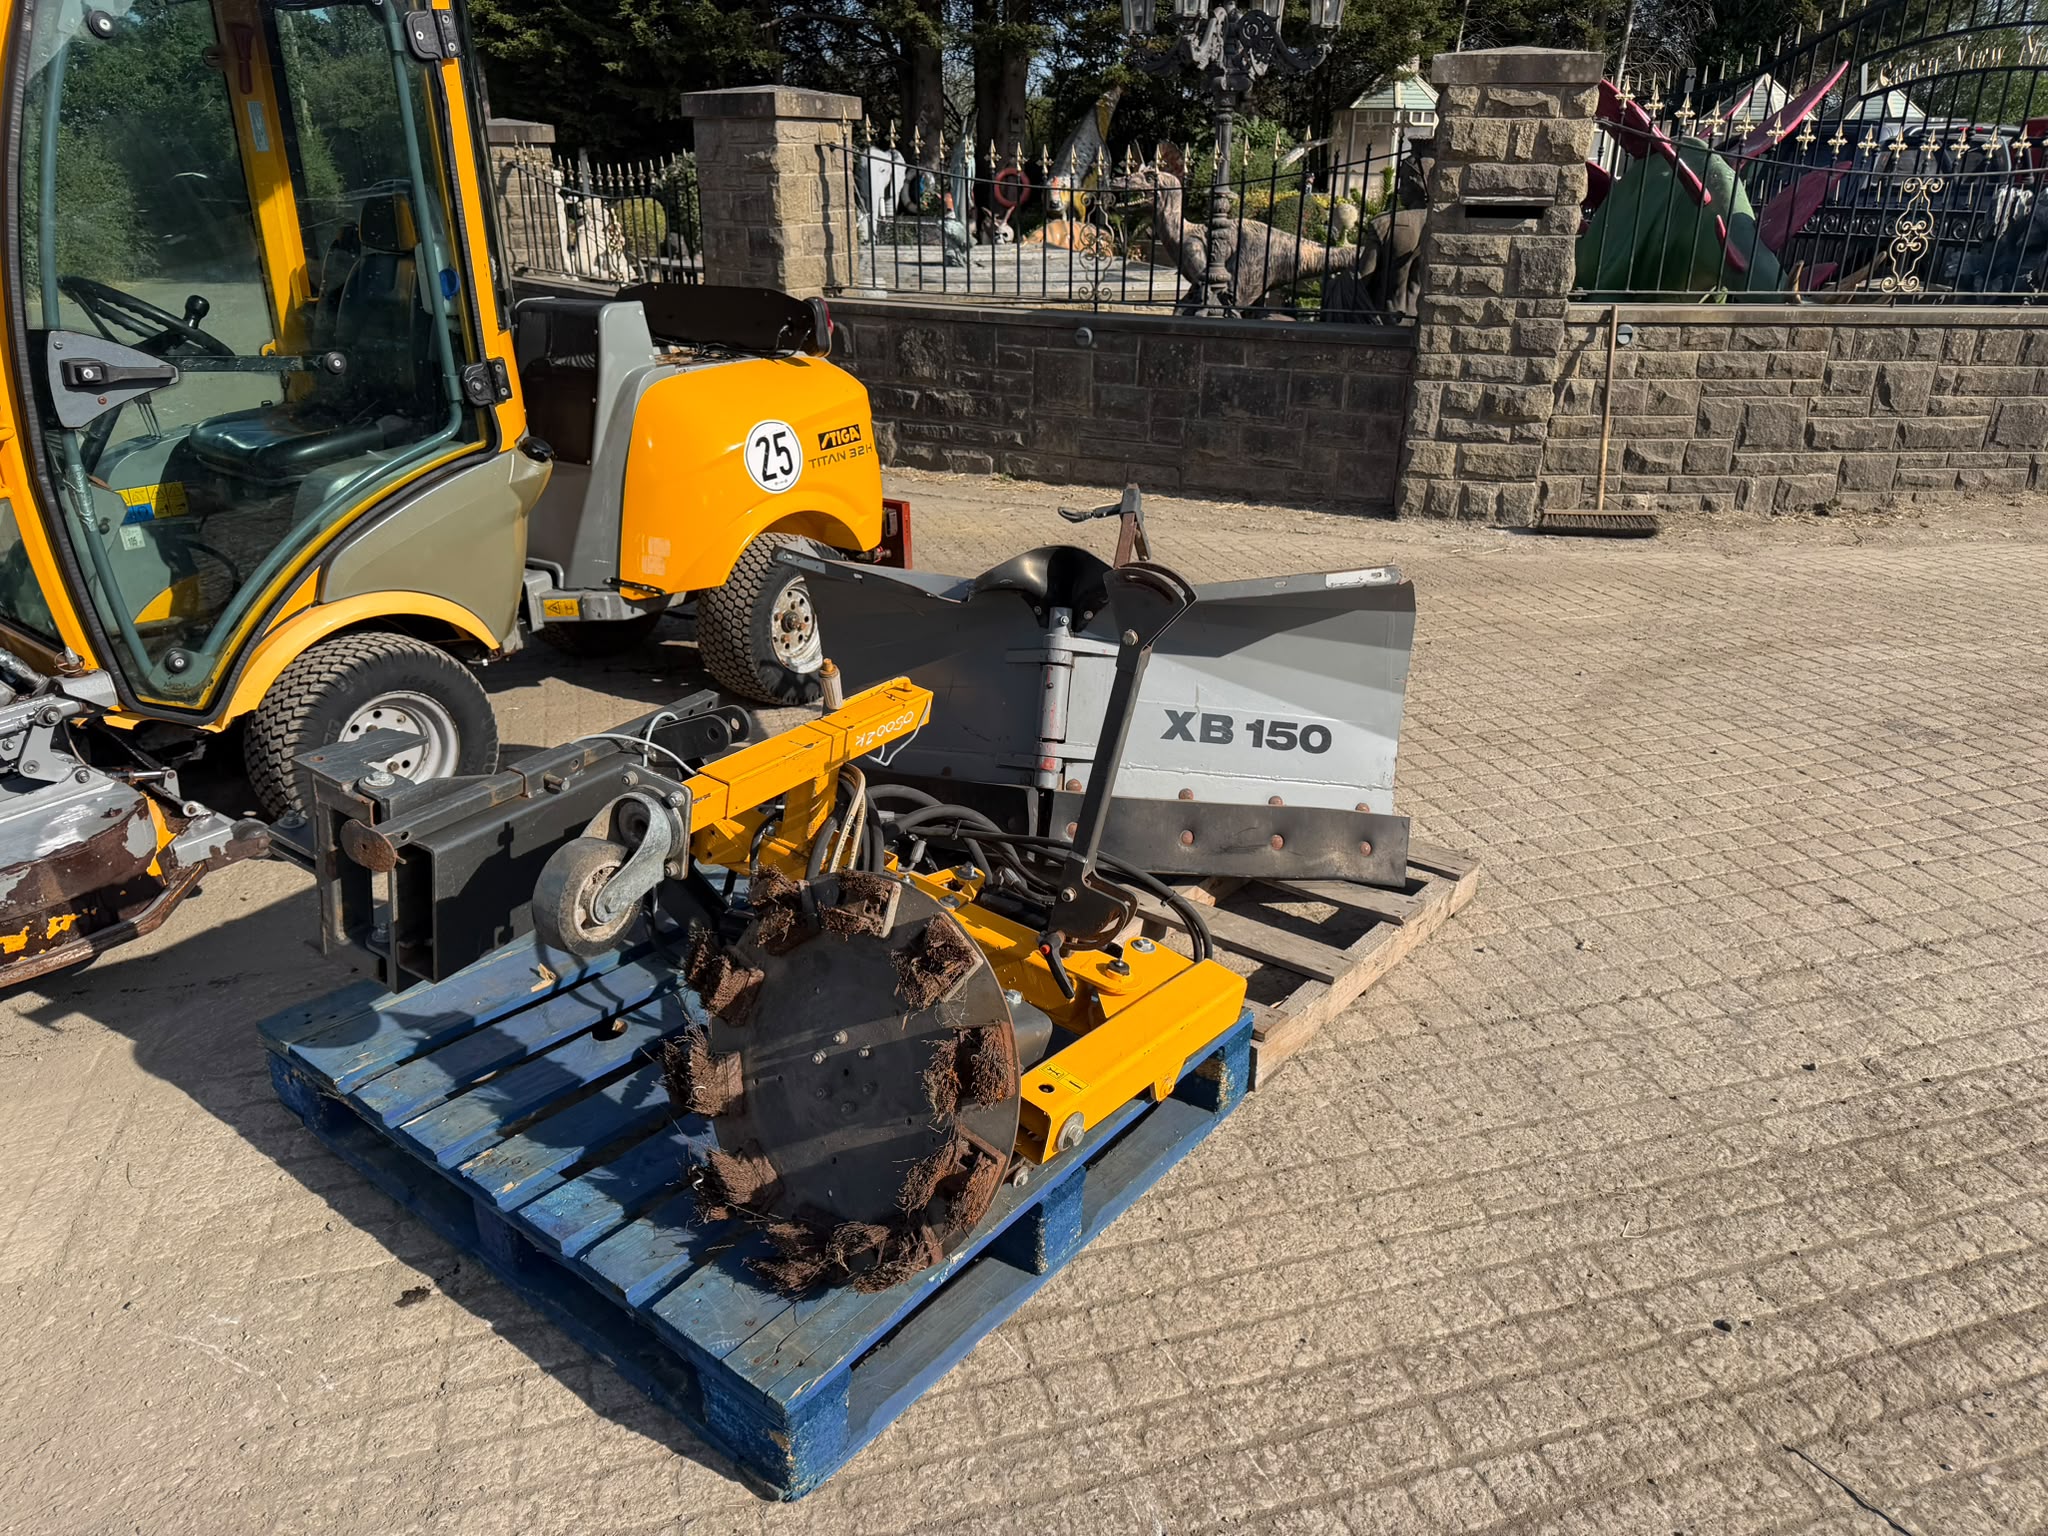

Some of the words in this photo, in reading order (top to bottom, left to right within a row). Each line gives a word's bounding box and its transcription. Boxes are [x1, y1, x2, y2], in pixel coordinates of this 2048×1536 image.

[819, 425, 860, 450] STIGA
[755, 431, 794, 482] 25
[808, 450, 847, 469] TITAN
[1160, 709, 1234, 745] XB
[1246, 719, 1332, 754] 150
